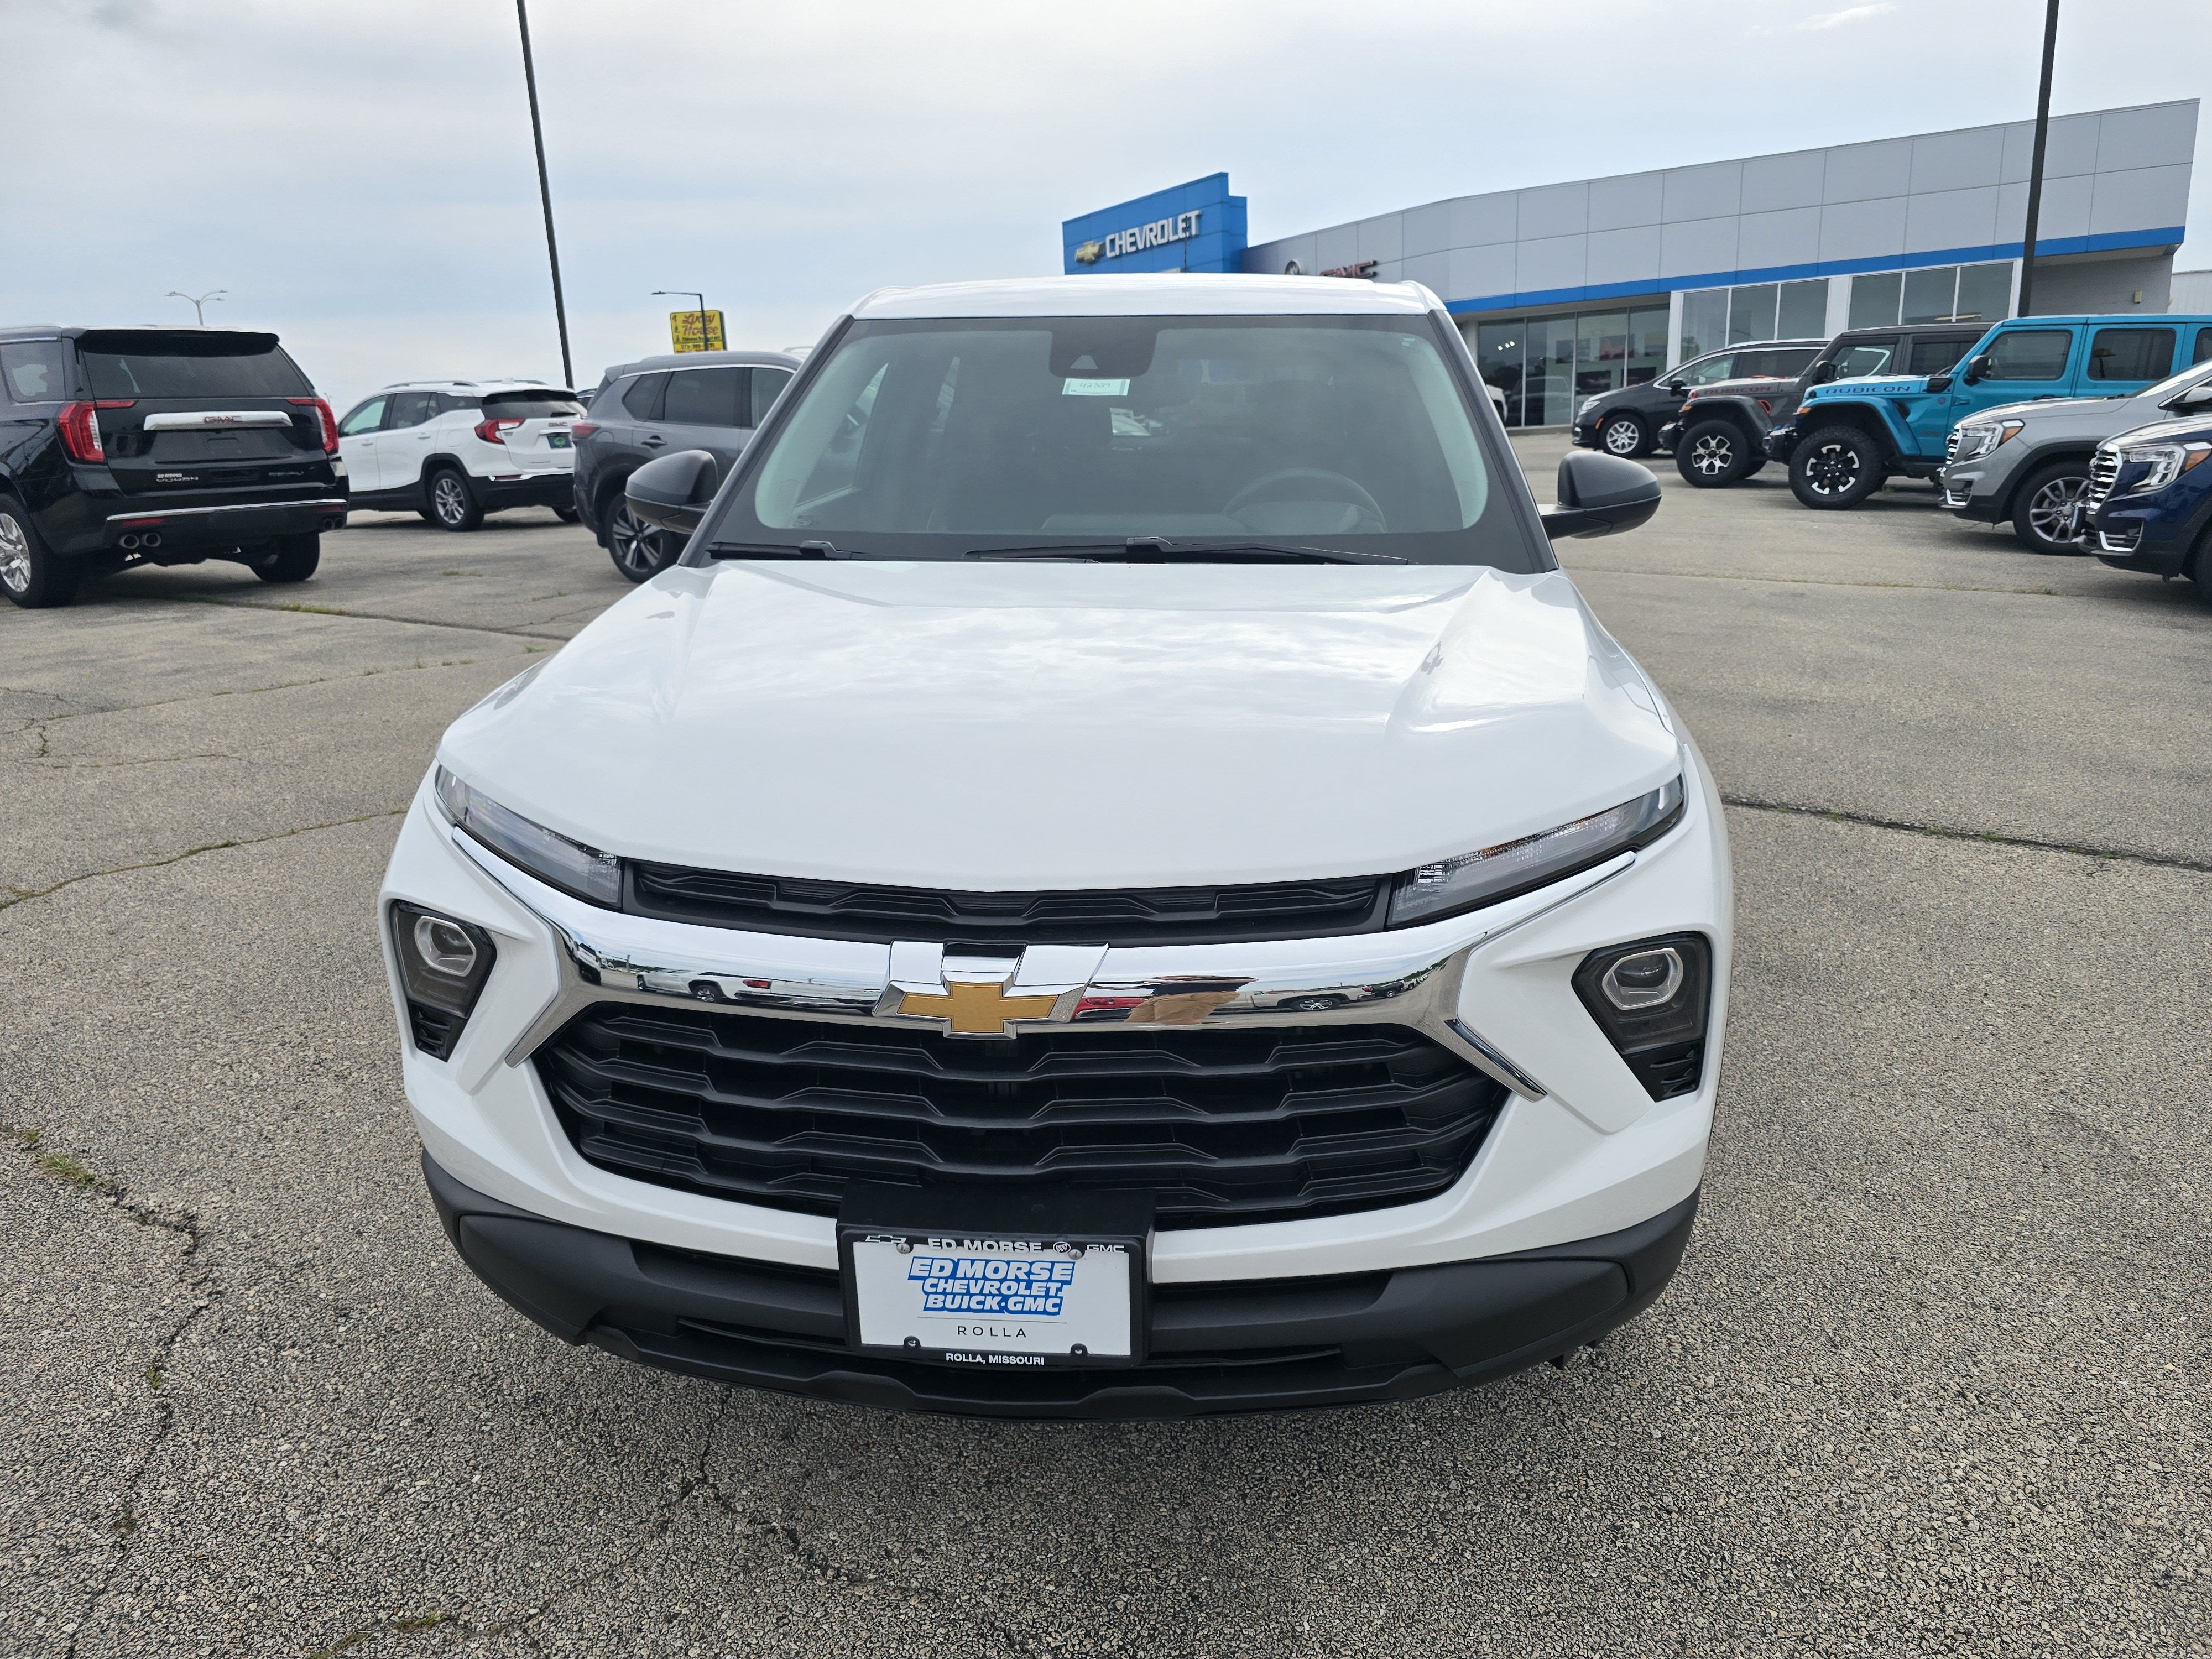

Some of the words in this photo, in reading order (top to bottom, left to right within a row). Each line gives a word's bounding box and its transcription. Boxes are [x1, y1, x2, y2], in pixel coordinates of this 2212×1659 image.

[1106, 210, 1202, 258] CHEVROLET
[1704, 387, 1772, 395] RUBICON
[1825, 386, 1910, 394] RUBICON
[204, 415, 243, 424] GMC
[928, 1238, 957, 1250] ED
[963, 1240, 1043, 1253] MORSE
[1086, 1244, 1125, 1253] GMC
[910, 1258, 953, 1277] ED
[956, 1260, 1073, 1281] MORSE
[924, 1278, 1061, 1297] CHEVROLET
[957, 1326, 1027, 1338] ROLLA
[946, 1353, 986, 1364] ROLLA,
[989, 1355, 1045, 1365] MISSOURI
